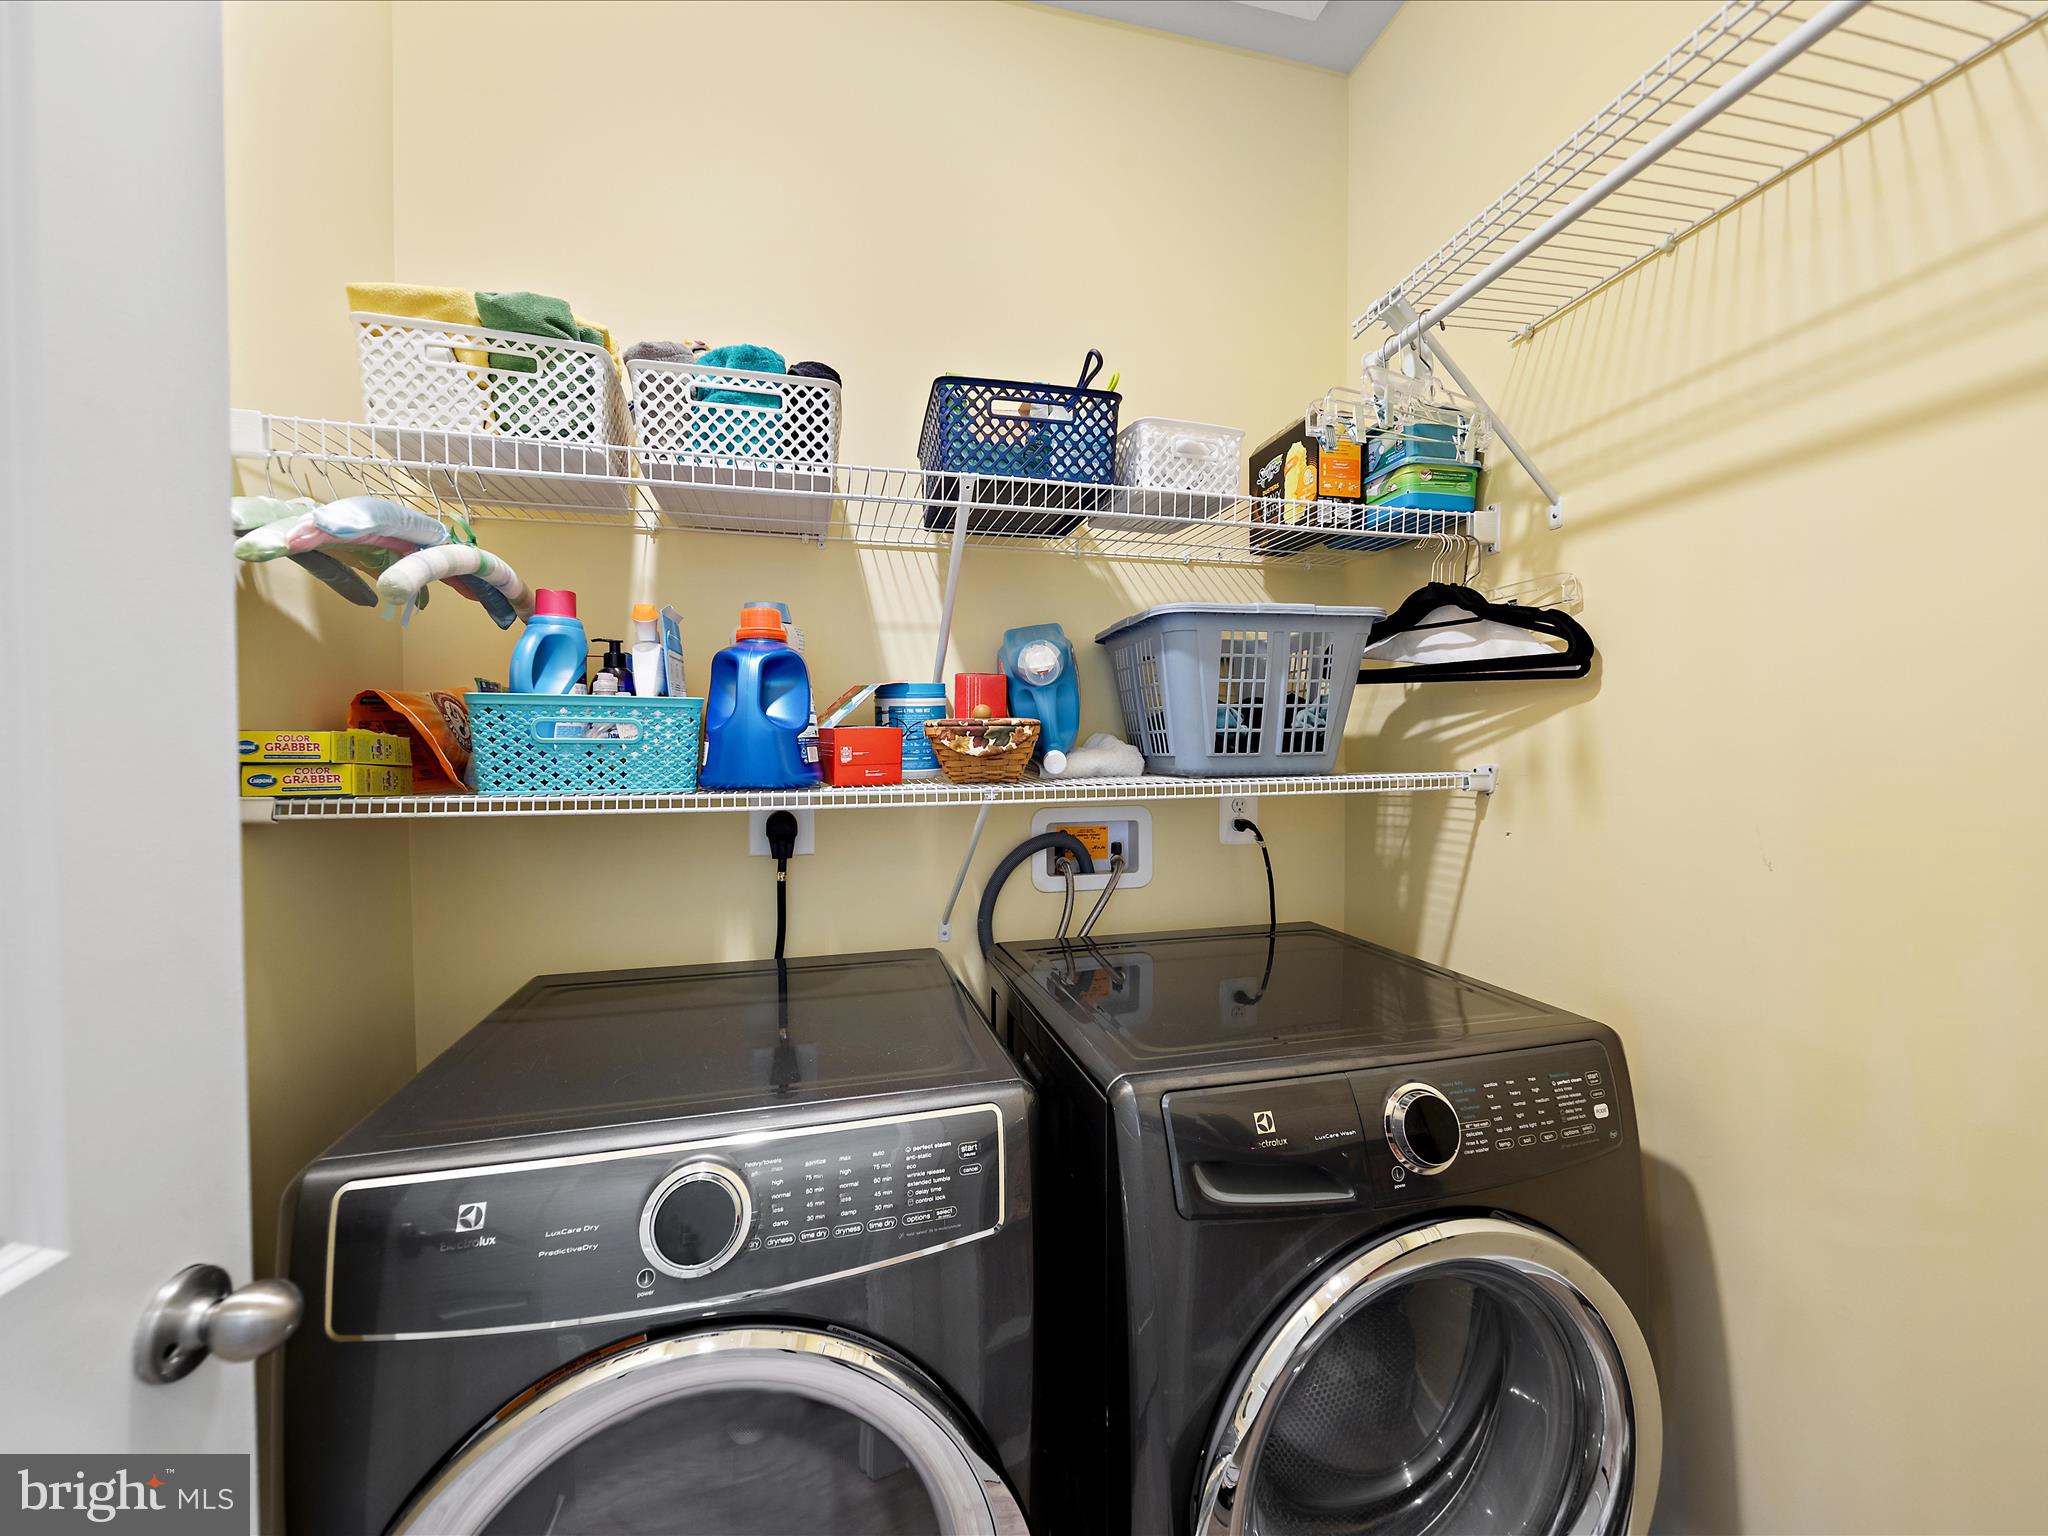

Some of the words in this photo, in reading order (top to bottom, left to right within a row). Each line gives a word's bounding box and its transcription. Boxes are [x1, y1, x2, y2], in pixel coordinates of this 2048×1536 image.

[265, 743, 320, 751] GRABBER
[282, 775, 341, 784] GRABBER
[1314, 1131, 1340, 1141] LuxCare
[1340, 1129, 1357, 1137] Wash
[913, 1144, 933, 1152] perfect
[961, 1144, 978, 1152] start
[839, 1168, 852, 1176] high
[927, 1168, 945, 1176] release
[839, 1181, 860, 1189] normal
[907, 1179, 932, 1187] extended
[933, 1176, 951, 1184] tumble
[771, 1191, 792, 1199] normal
[840, 1209, 857, 1217] damp
[906, 1214, 931, 1223] options
[936, 1208, 953, 1216] select
[773, 1220, 789, 1228] damp
[869, 1221, 883, 1229] time
[885, 1219, 895, 1227] dry
[545, 1226, 582, 1238] LuxCare
[584, 1223, 600, 1232] Dry
[835, 1225, 861, 1235] dryness
[801, 1231, 815, 1240] time
[816, 1230, 827, 1239] dry
[767, 1235, 793, 1246] dryness
[538, 1242, 599, 1258] PredictiveDry
[636, 1289, 655, 1298] power
